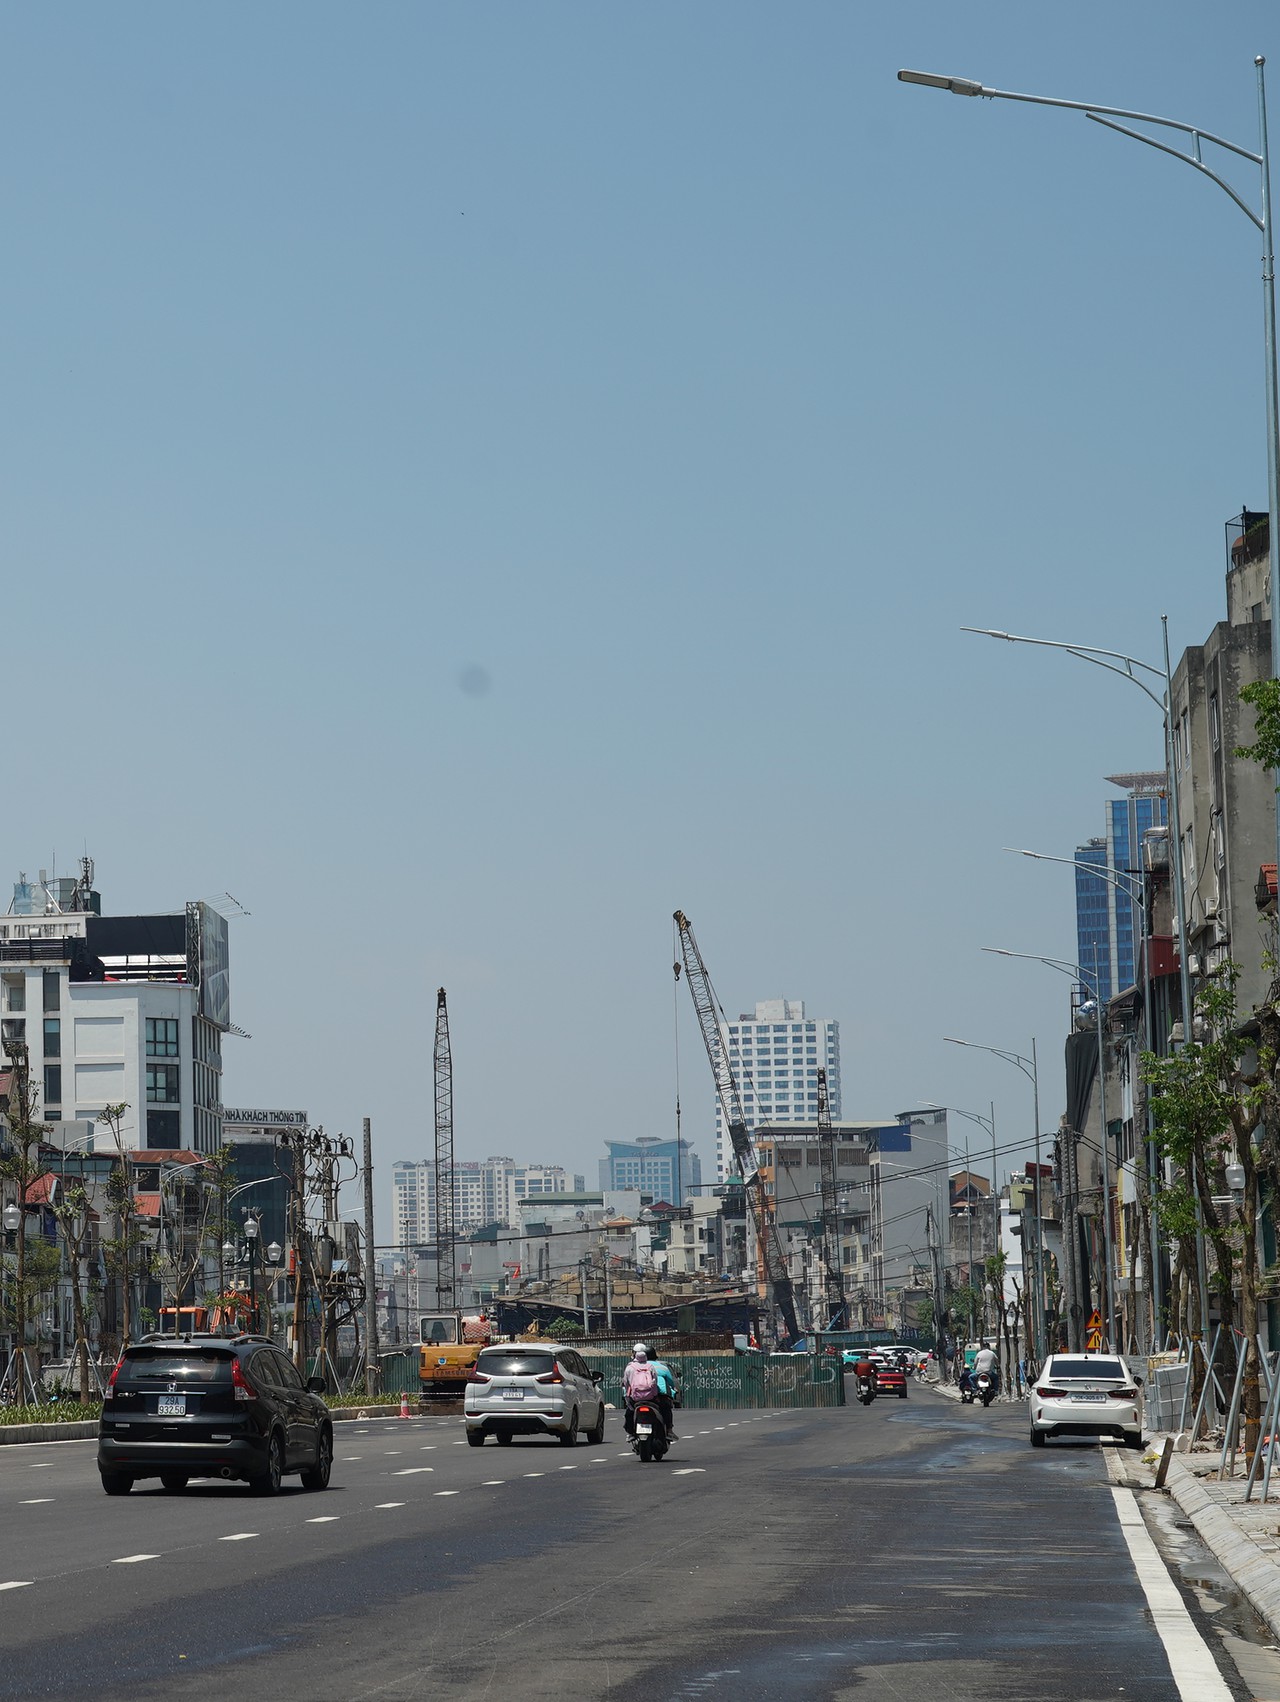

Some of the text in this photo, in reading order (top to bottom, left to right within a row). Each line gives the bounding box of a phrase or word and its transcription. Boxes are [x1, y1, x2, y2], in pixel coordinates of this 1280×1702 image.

[225, 1108, 240, 1120] NHÀ
[241, 1109, 267, 1122] KHÁCH
[269, 1110, 294, 1122] THÔNG
[165, 1396, 179, 1406] 29A
